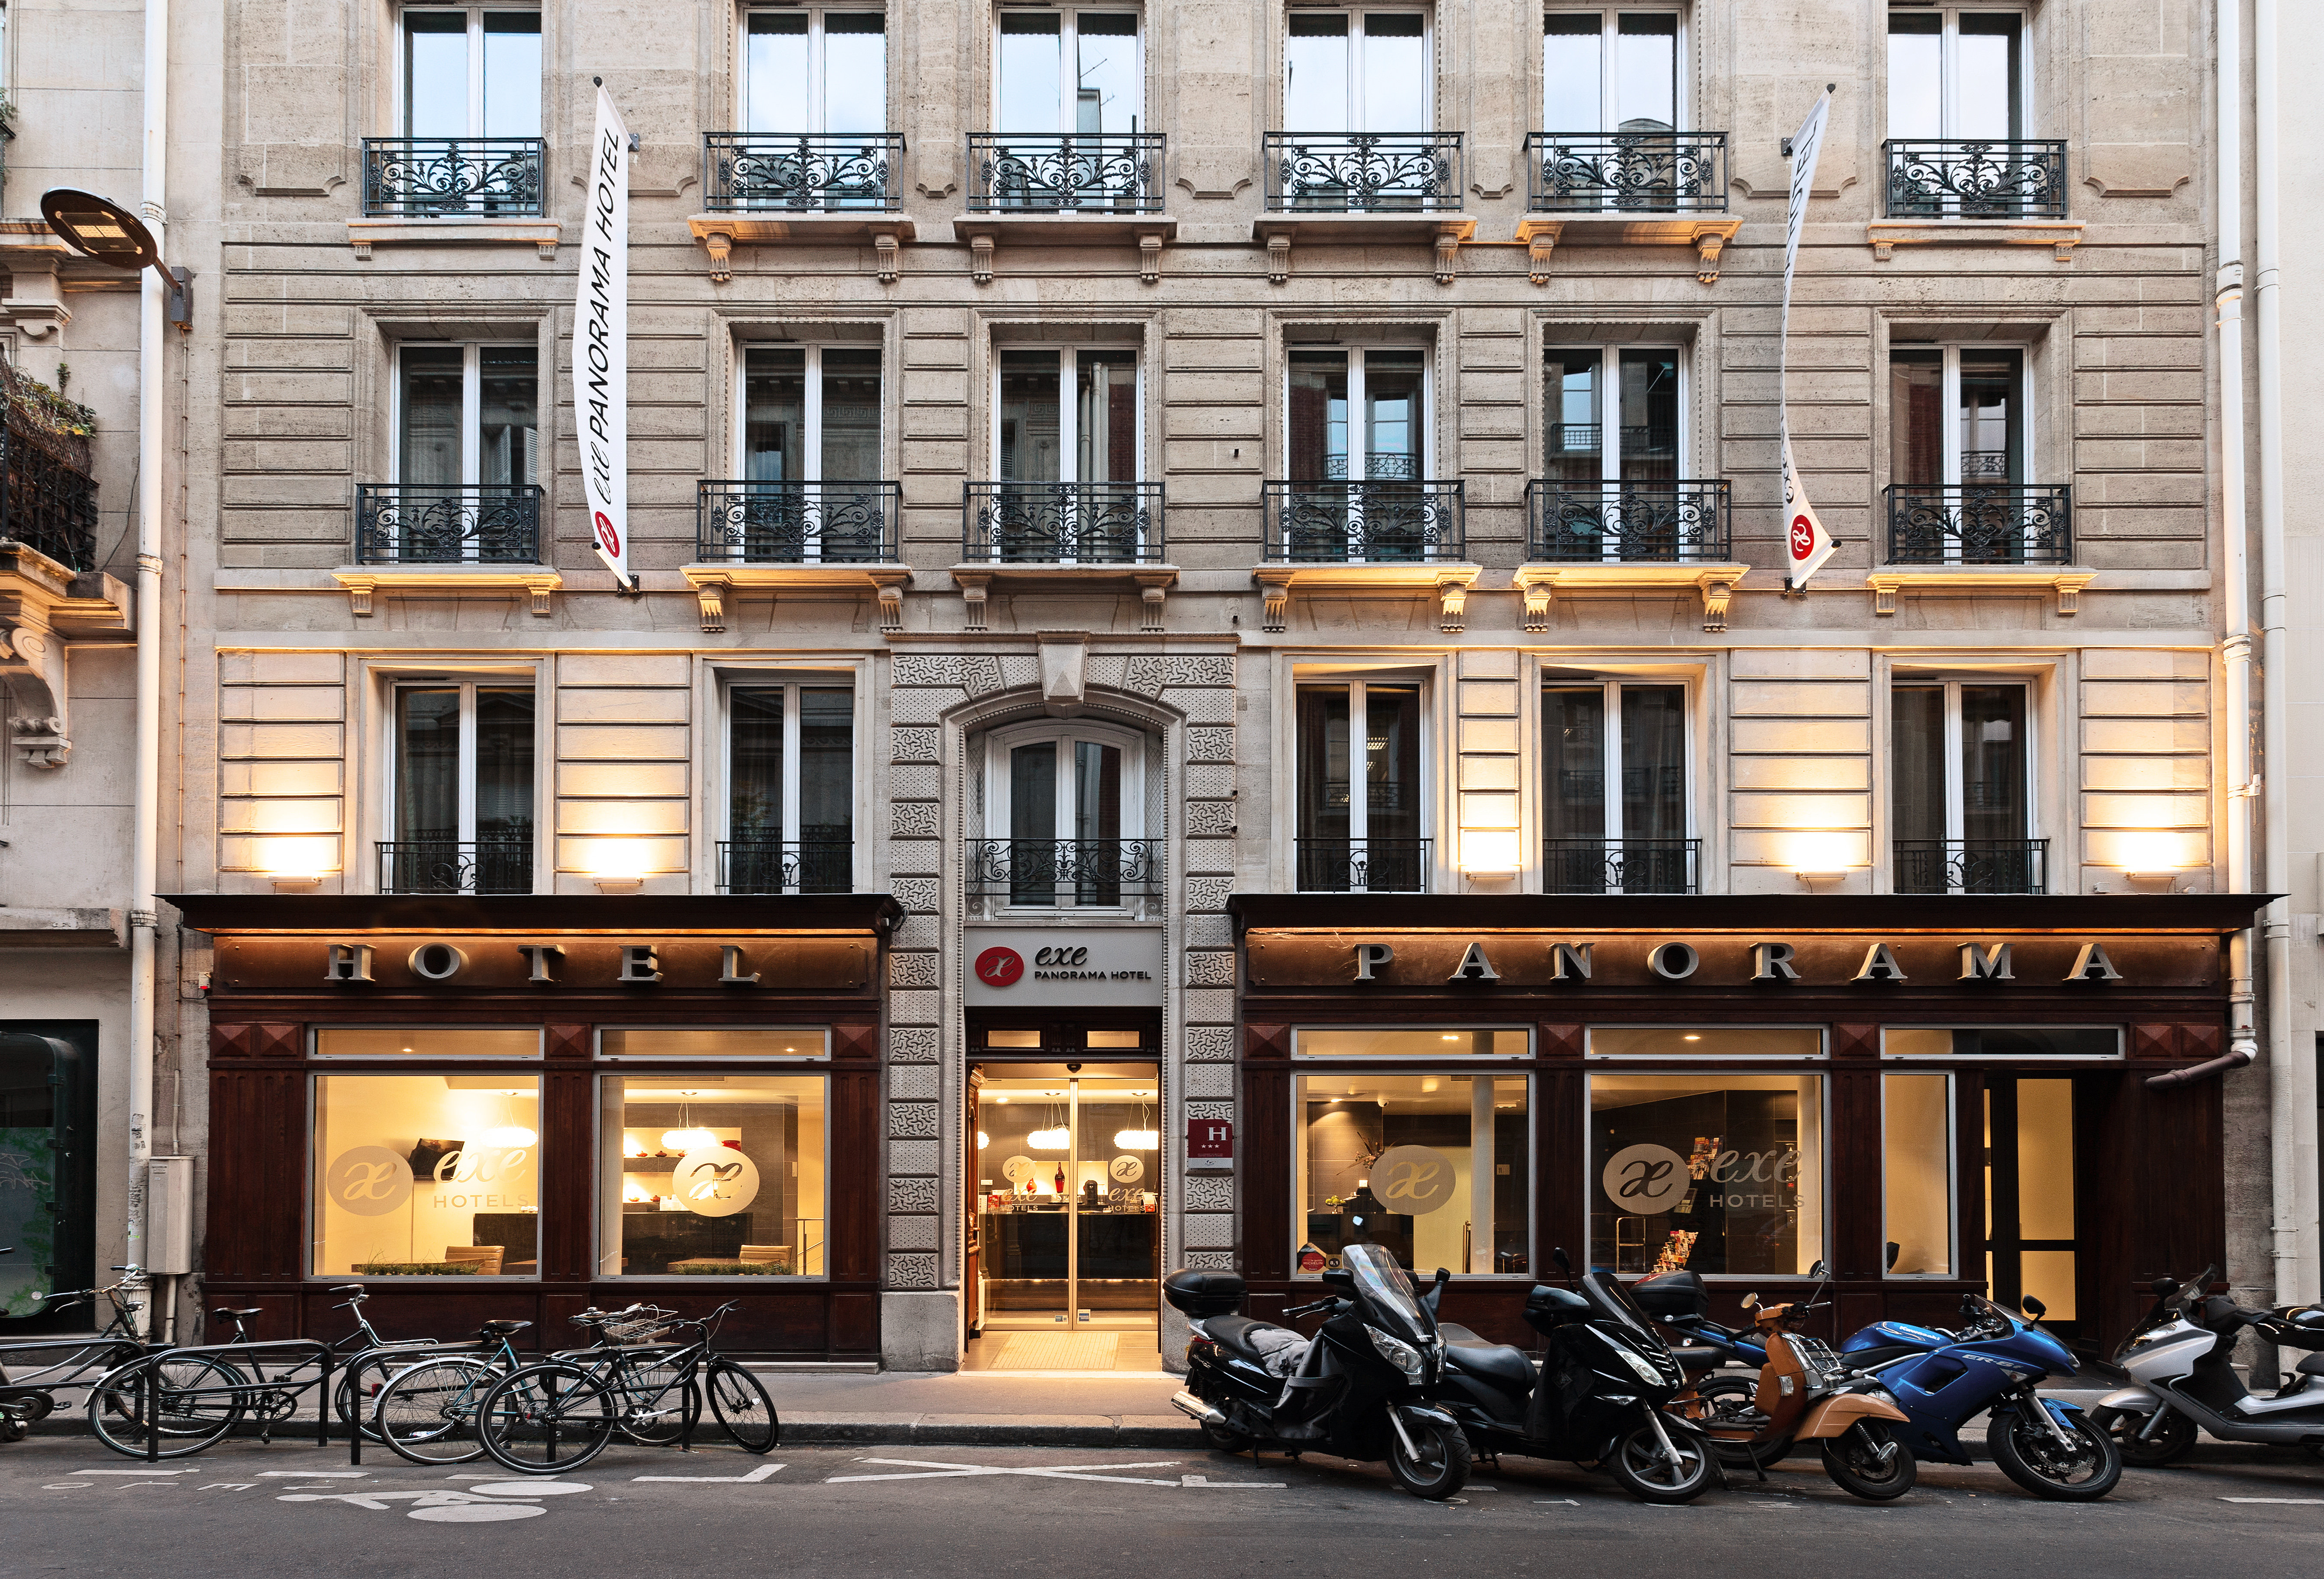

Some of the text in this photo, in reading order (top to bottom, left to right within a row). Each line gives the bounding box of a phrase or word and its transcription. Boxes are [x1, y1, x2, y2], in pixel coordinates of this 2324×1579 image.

[594, 129, 621, 242] HOTEL
[588, 247, 611, 444] PANORAMA
[591, 441, 611, 505] exe
[324, 942, 761, 982] HOTEL
[1035, 946, 1087, 966] exe
[1353, 942, 2123, 981] PANORAMA
[1035, 971, 1152, 980] PANORAMA HOTEL
[1207, 1127, 1228, 1141] H
[434, 1150, 526, 1183] exe
[1710, 1150, 1803, 1183] exe
[434, 1194, 529, 1208] HOTELS
[1109, 1188, 1145, 1201] exe
[1710, 1195, 1805, 1208] HOTELS
[1899, 1326, 1940, 1341] Kawasaki
